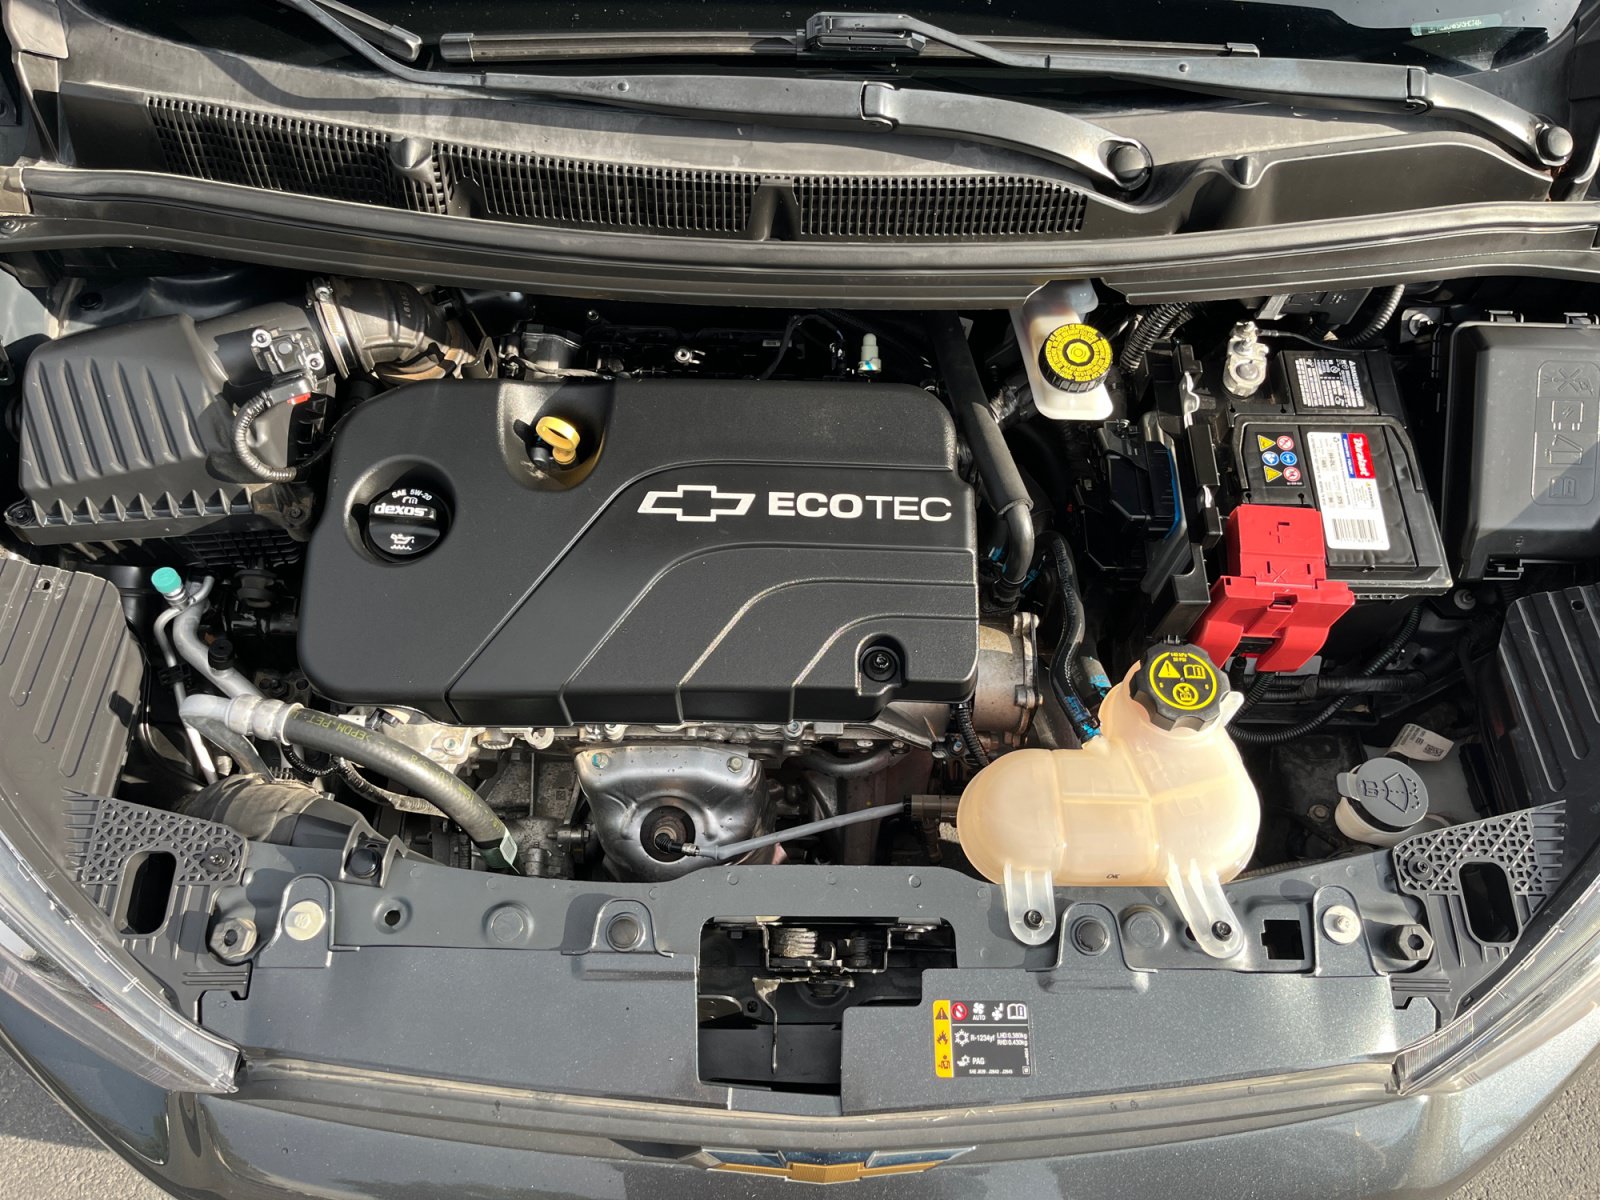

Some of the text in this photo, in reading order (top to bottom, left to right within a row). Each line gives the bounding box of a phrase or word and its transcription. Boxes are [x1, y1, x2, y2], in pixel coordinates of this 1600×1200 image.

[1353, 436, 1371, 477] Duralast
[391, 488, 407, 499] SAE
[768, 491, 952, 522] ECOTEC
[970, 1033, 996, 1043] R-1234yf
[972, 1057, 986, 1065] PAG
